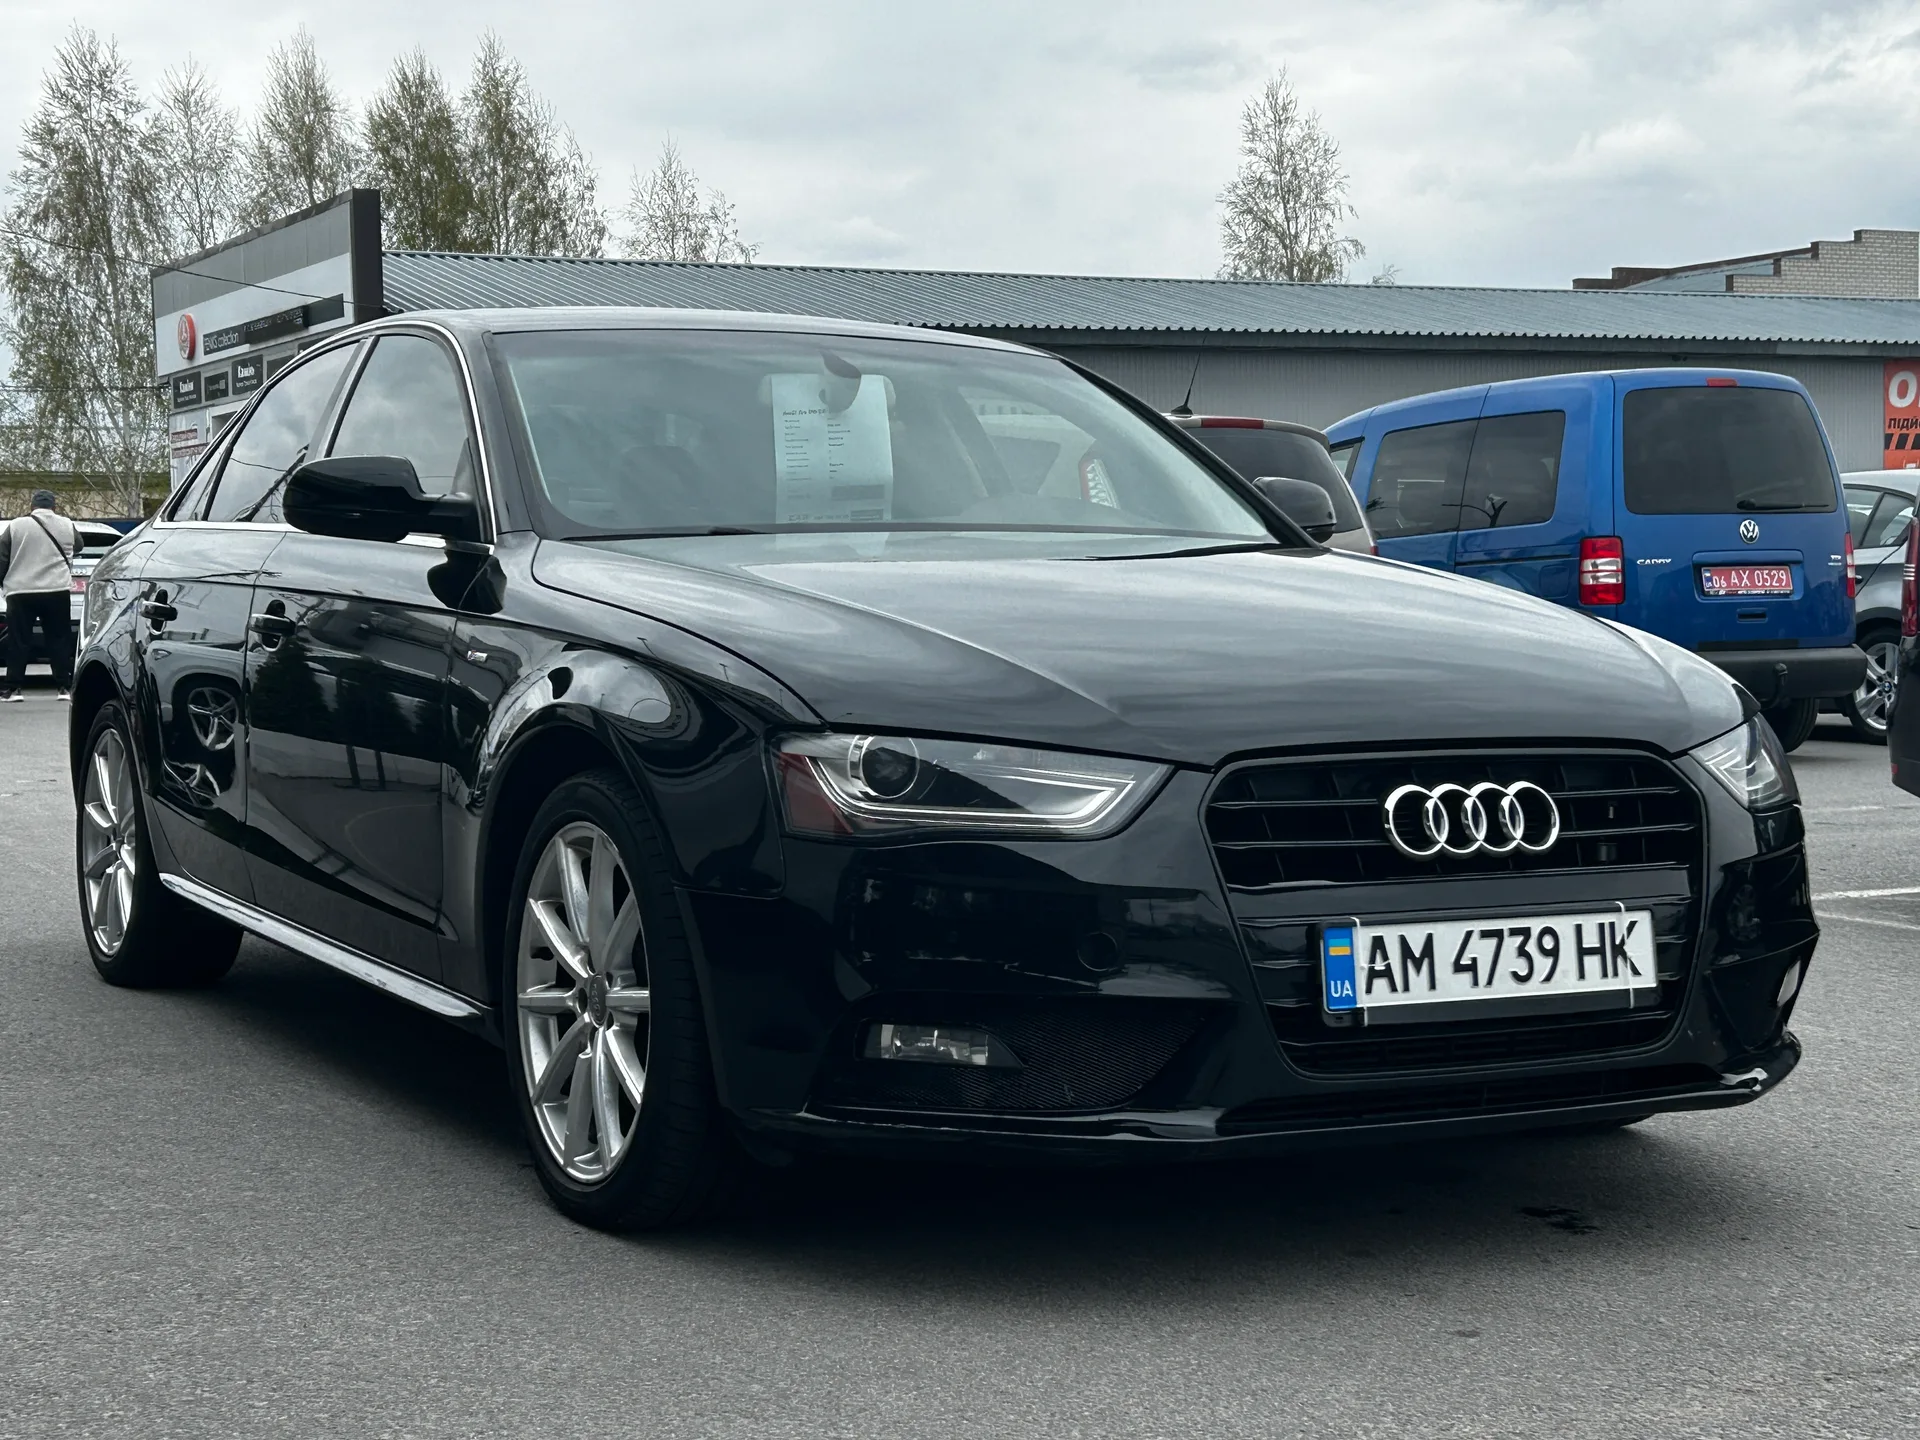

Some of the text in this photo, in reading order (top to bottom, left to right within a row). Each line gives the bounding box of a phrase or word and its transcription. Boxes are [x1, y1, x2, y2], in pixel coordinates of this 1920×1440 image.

[1888, 370, 1920, 409] О
[1712, 569, 1787, 588] 06 AX 0529
[1365, 920, 1643, 995] AM 4739 HK
[1330, 979, 1353, 998] UA
